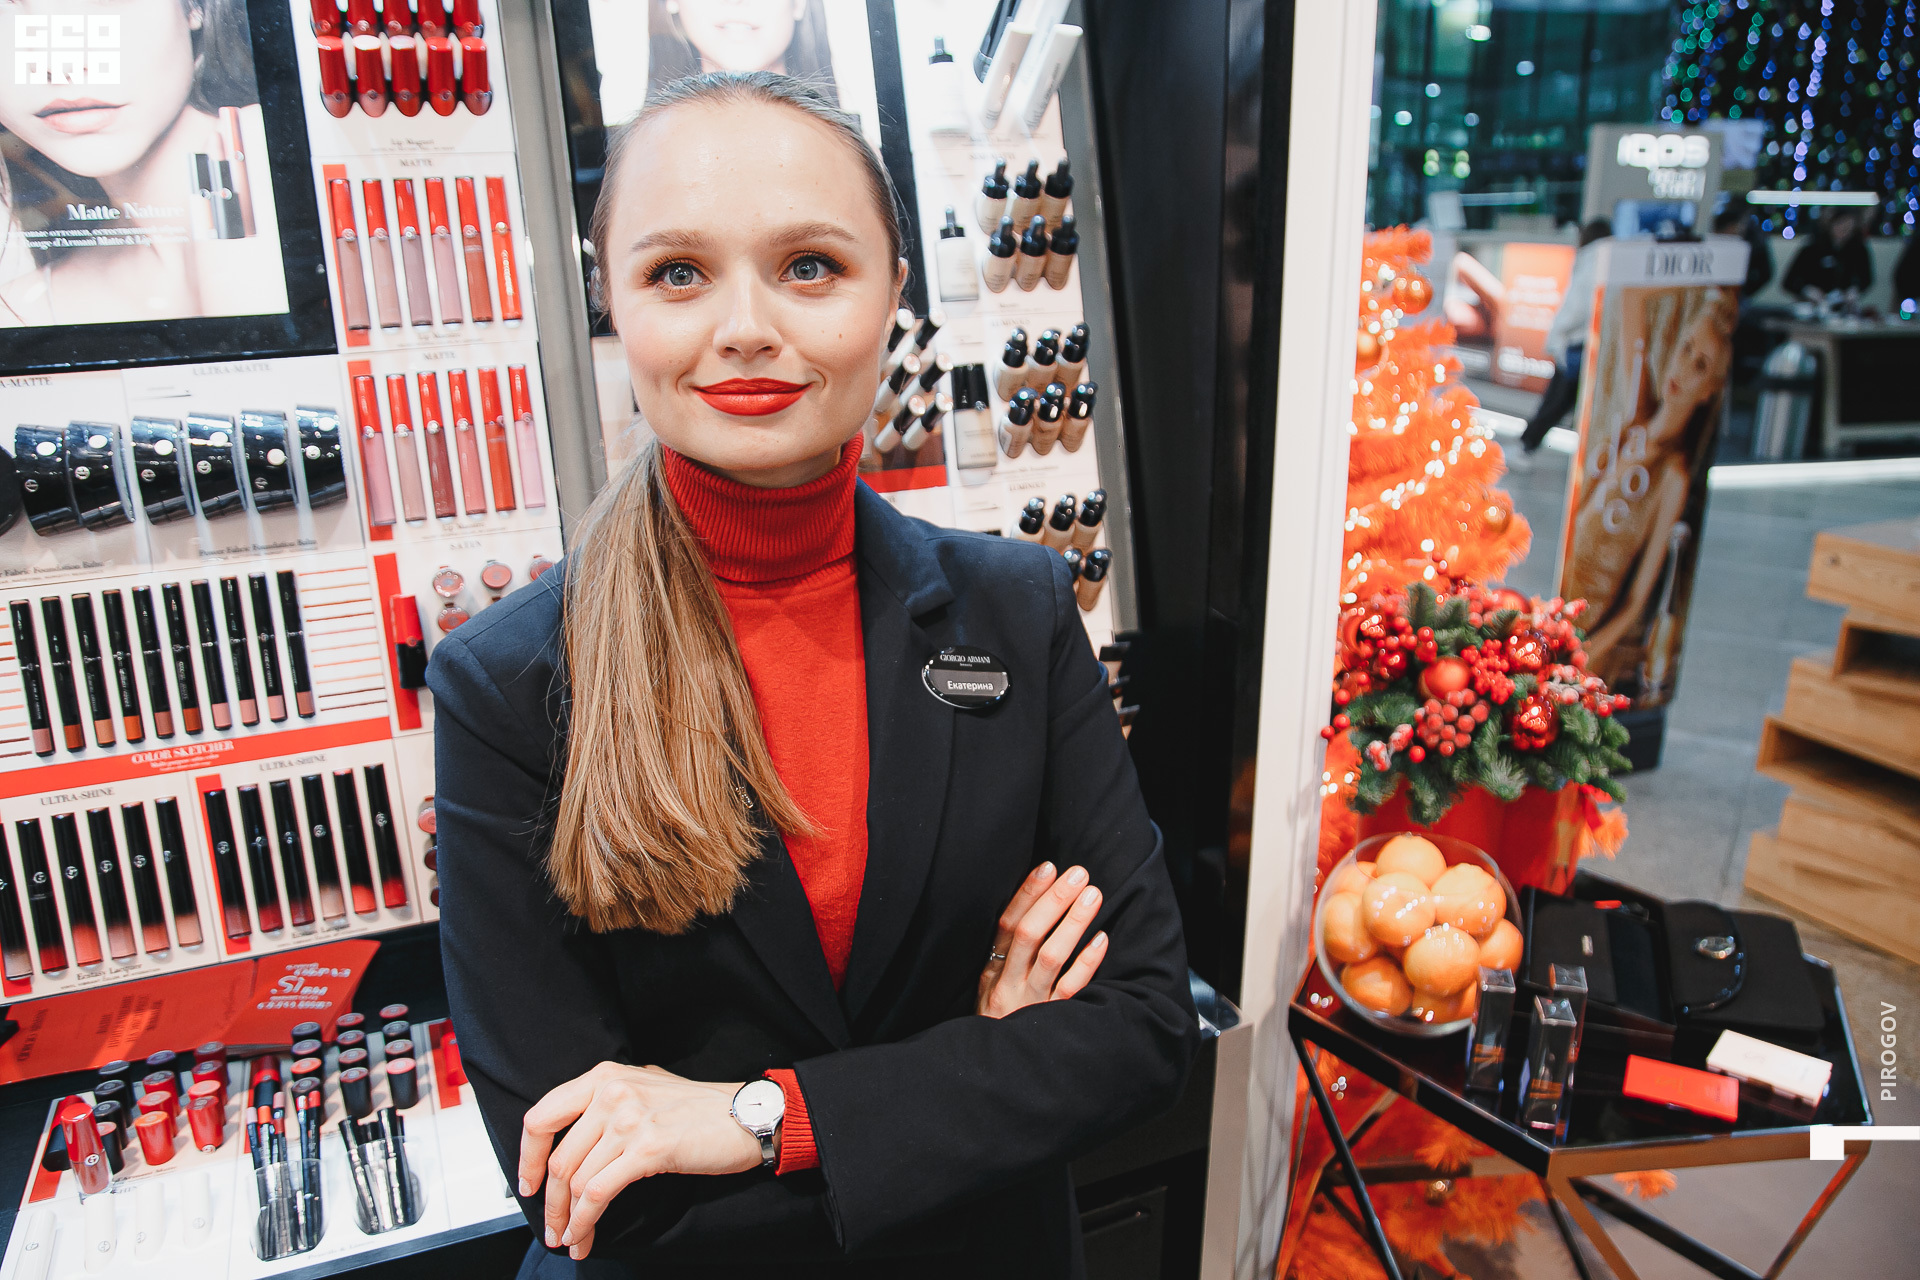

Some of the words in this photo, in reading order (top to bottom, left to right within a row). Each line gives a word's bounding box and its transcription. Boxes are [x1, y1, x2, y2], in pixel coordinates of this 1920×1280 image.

[66, 203, 121, 221] Matte
[123, 202, 185, 220] Nature
[1645, 250, 1714, 277] DIOR
[192, 362, 272, 376] ULTRA-MATTE
[940, 654, 966, 663] GIORGIO
[967, 656, 991, 664] ARMANI
[947, 680, 994, 691] Екатерина
[131, 749, 172, 764] COLOR
[173, 740, 235, 758] SKETCHER
[40, 787, 115, 806] ULTRA-SHINE
